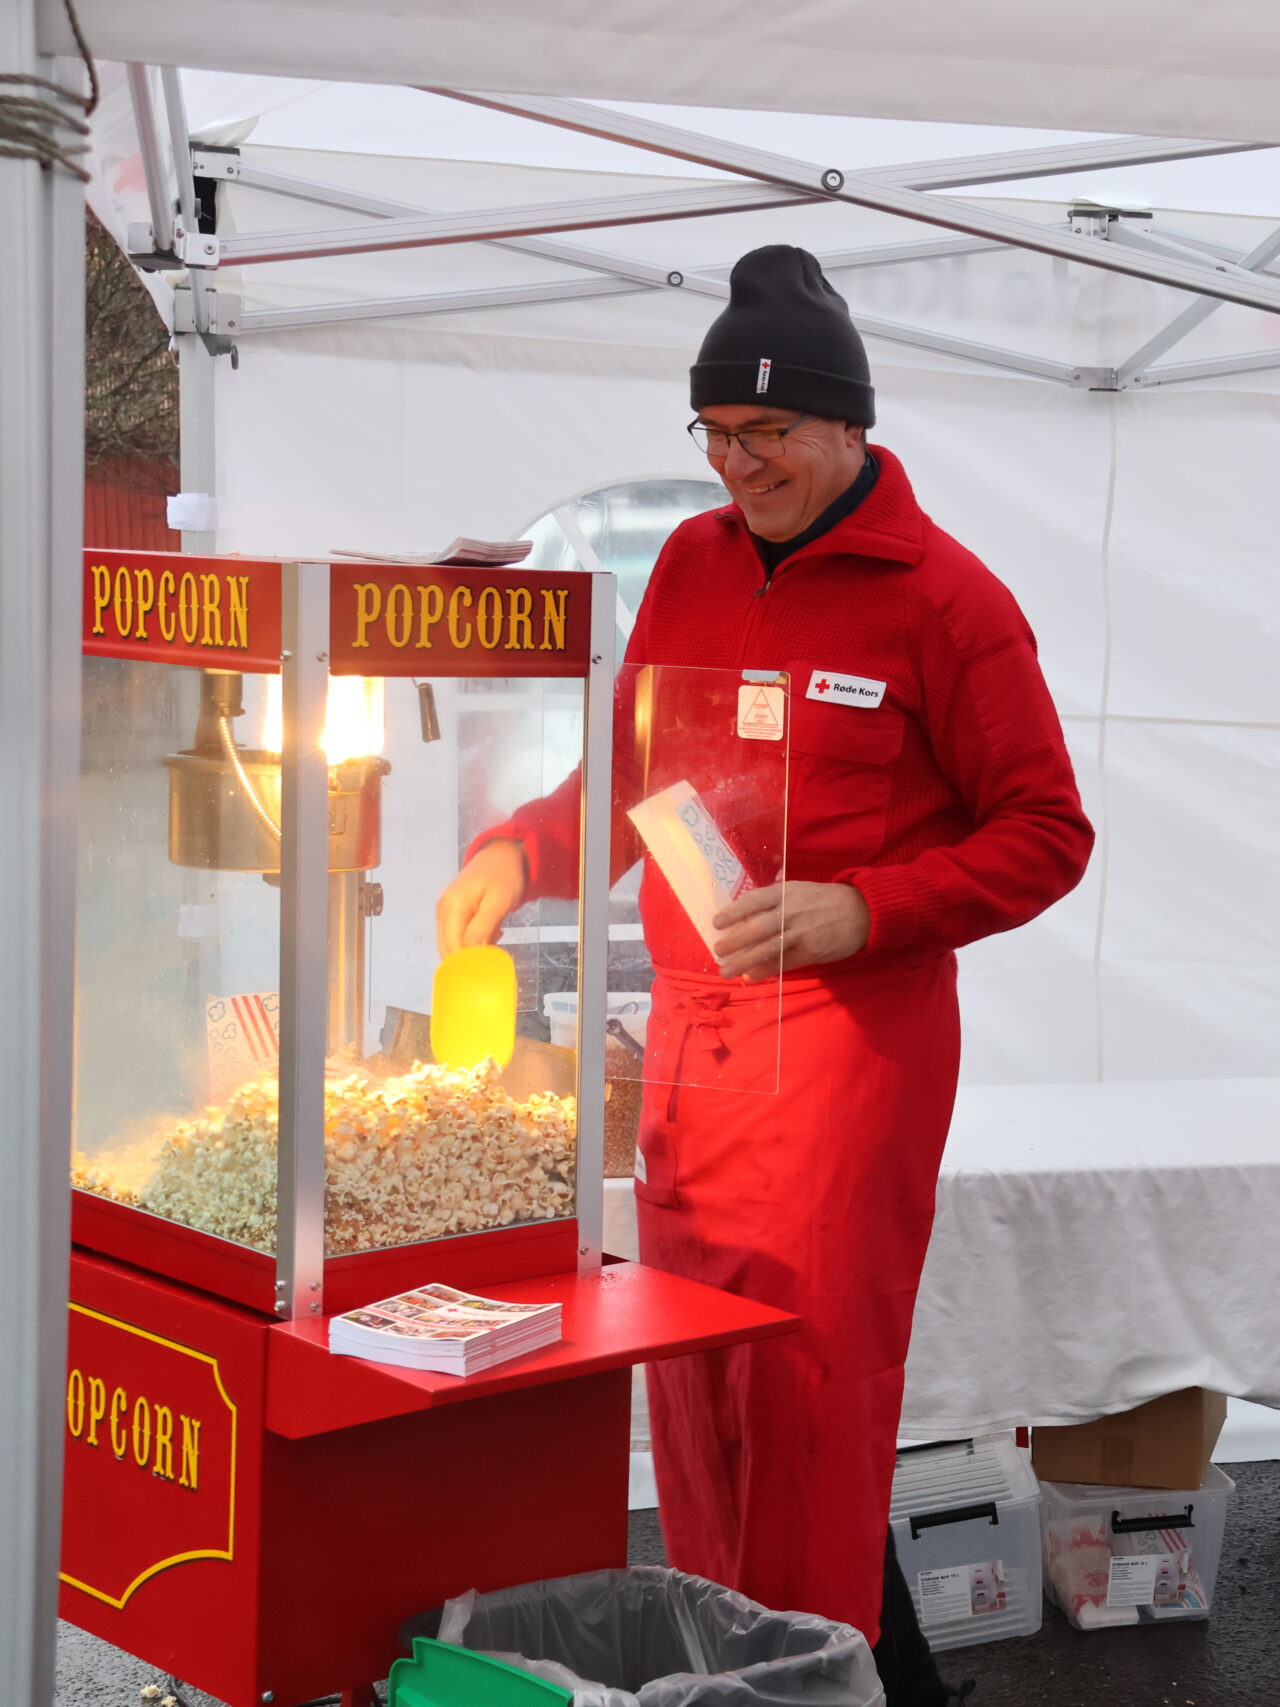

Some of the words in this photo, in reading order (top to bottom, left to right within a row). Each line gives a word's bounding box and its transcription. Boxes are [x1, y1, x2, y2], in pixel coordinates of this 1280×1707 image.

[91, 565, 250, 648] POPCORN
[352, 582, 568, 650] POPCORN
[833, 683, 857, 694] Røde
[858, 687, 879, 698] Kors
[67, 1368, 201, 1489] OPCORN
